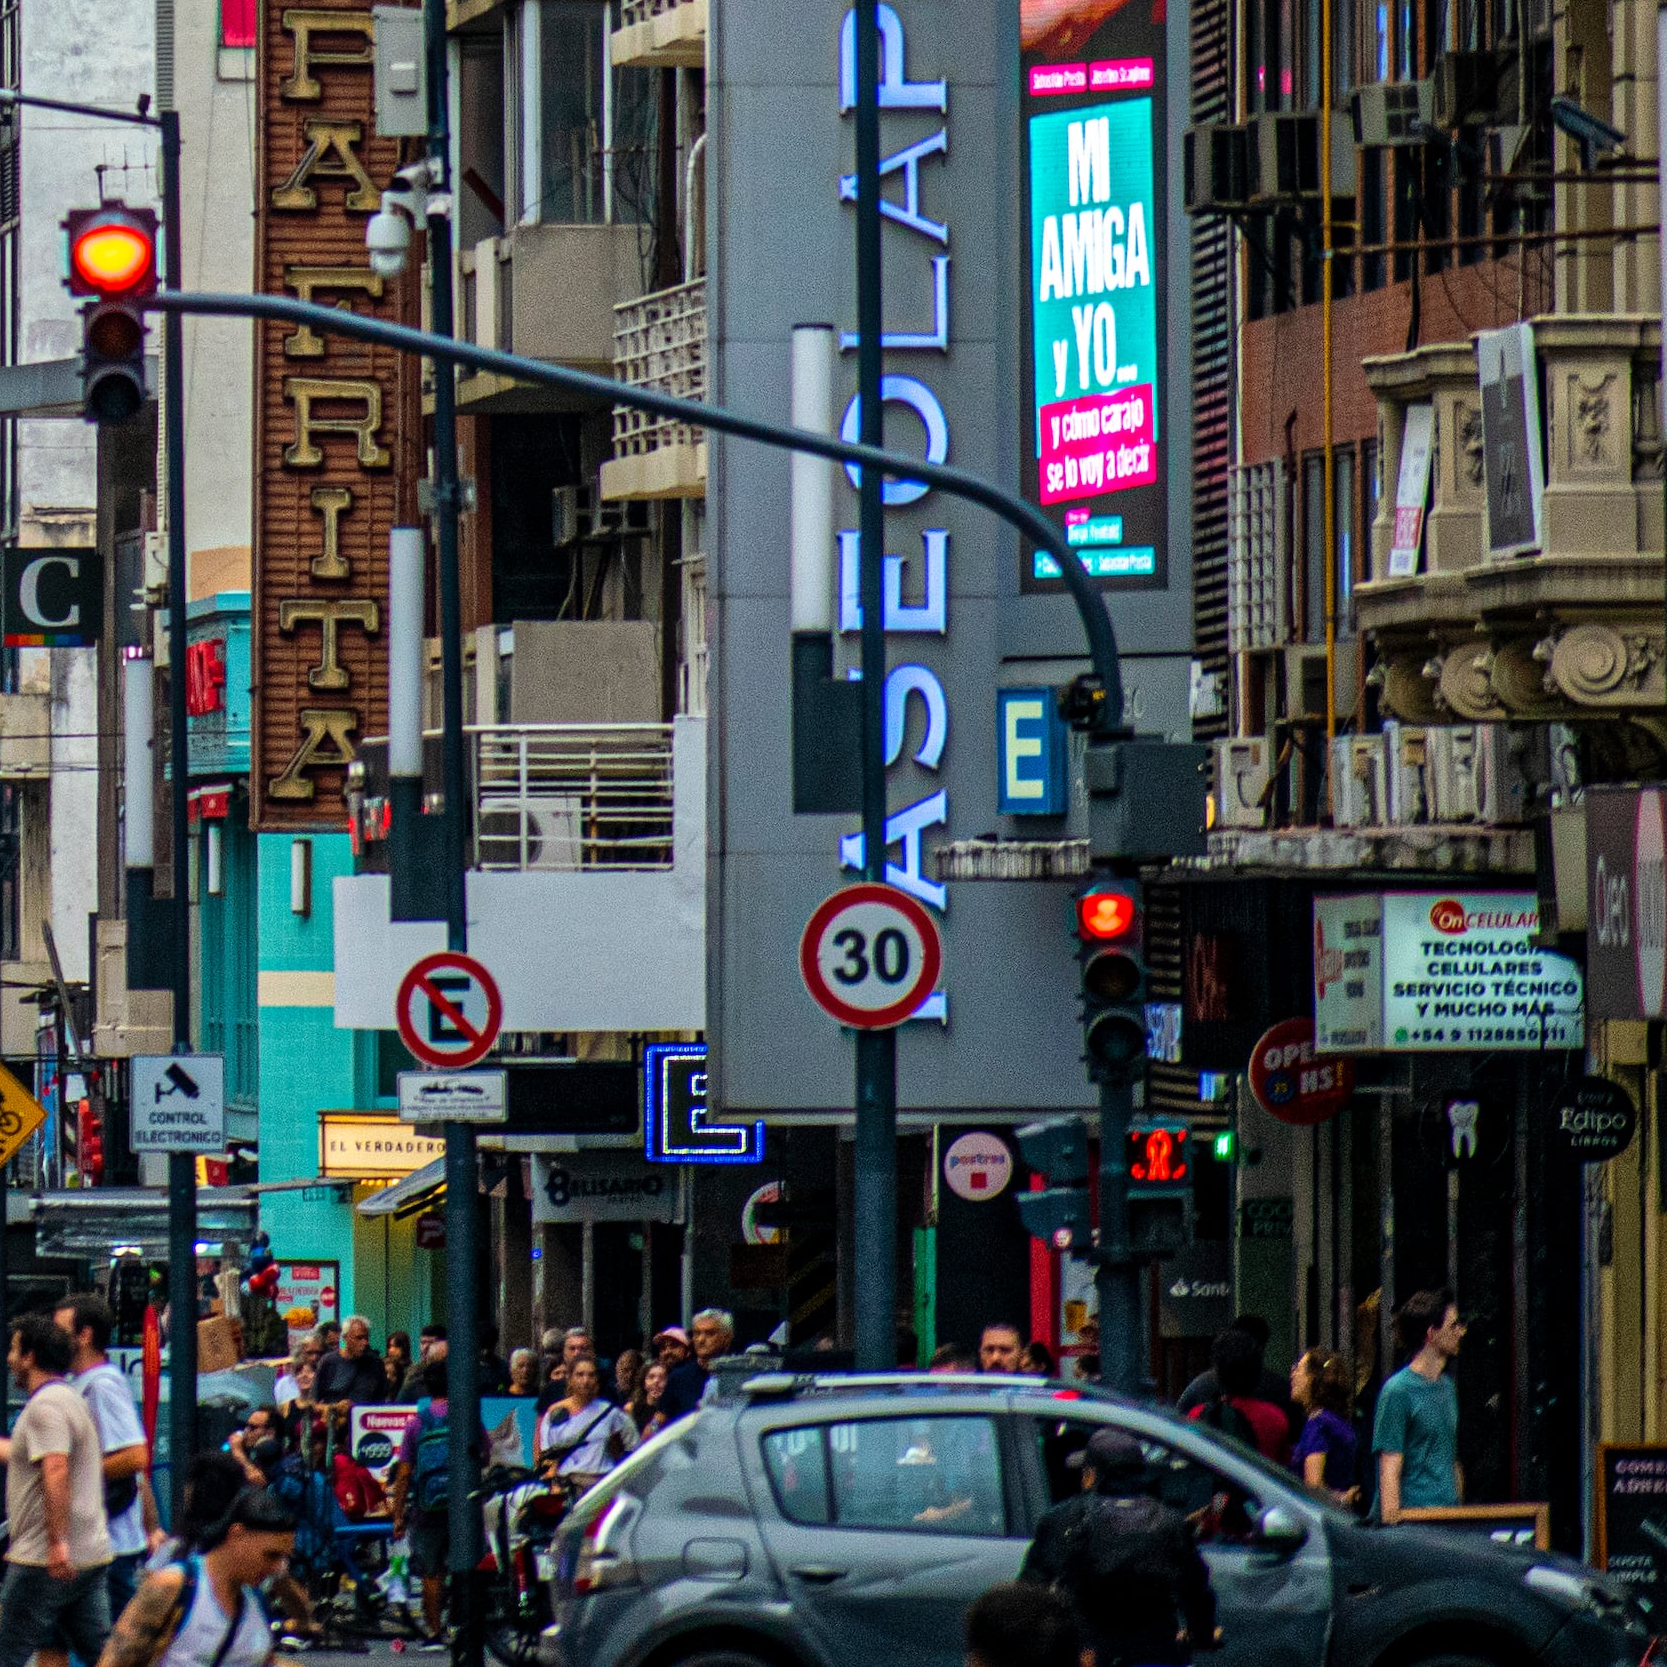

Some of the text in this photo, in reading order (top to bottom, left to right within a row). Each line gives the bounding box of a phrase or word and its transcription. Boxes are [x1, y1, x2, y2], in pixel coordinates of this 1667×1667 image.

[1068, 117, 1110, 206] MI
[1040, 202, 1150, 302] AMIGA
[1053, 339, 1067, 397] y
[1051, 415, 1060, 450] y
[1101, 394, 1143, 440] carajo
[1047, 438, 1150, 493] se lo voy a decir
[268, 265, 393, 799] FRITA
[18, 555, 82, 627] C
[1004, 700, 1045, 800] E
[833, 925, 908, 985] 30
[1427, 960, 1543, 977] CELULARES
[1393, 977, 1578, 998] SERVICIO TÉCNICO
[1416, 998, 1555, 1018] Y MUCHO MÁS
[1264, 1042, 1318, 1071] OPE
[134, 1130, 222, 1144] ELECTRONICO
[149, 1111, 208, 1125] CONTROL
[1560, 1105, 1628, 1133] Edipo
[330, 1141, 447, 1153] EL VERDADERO
